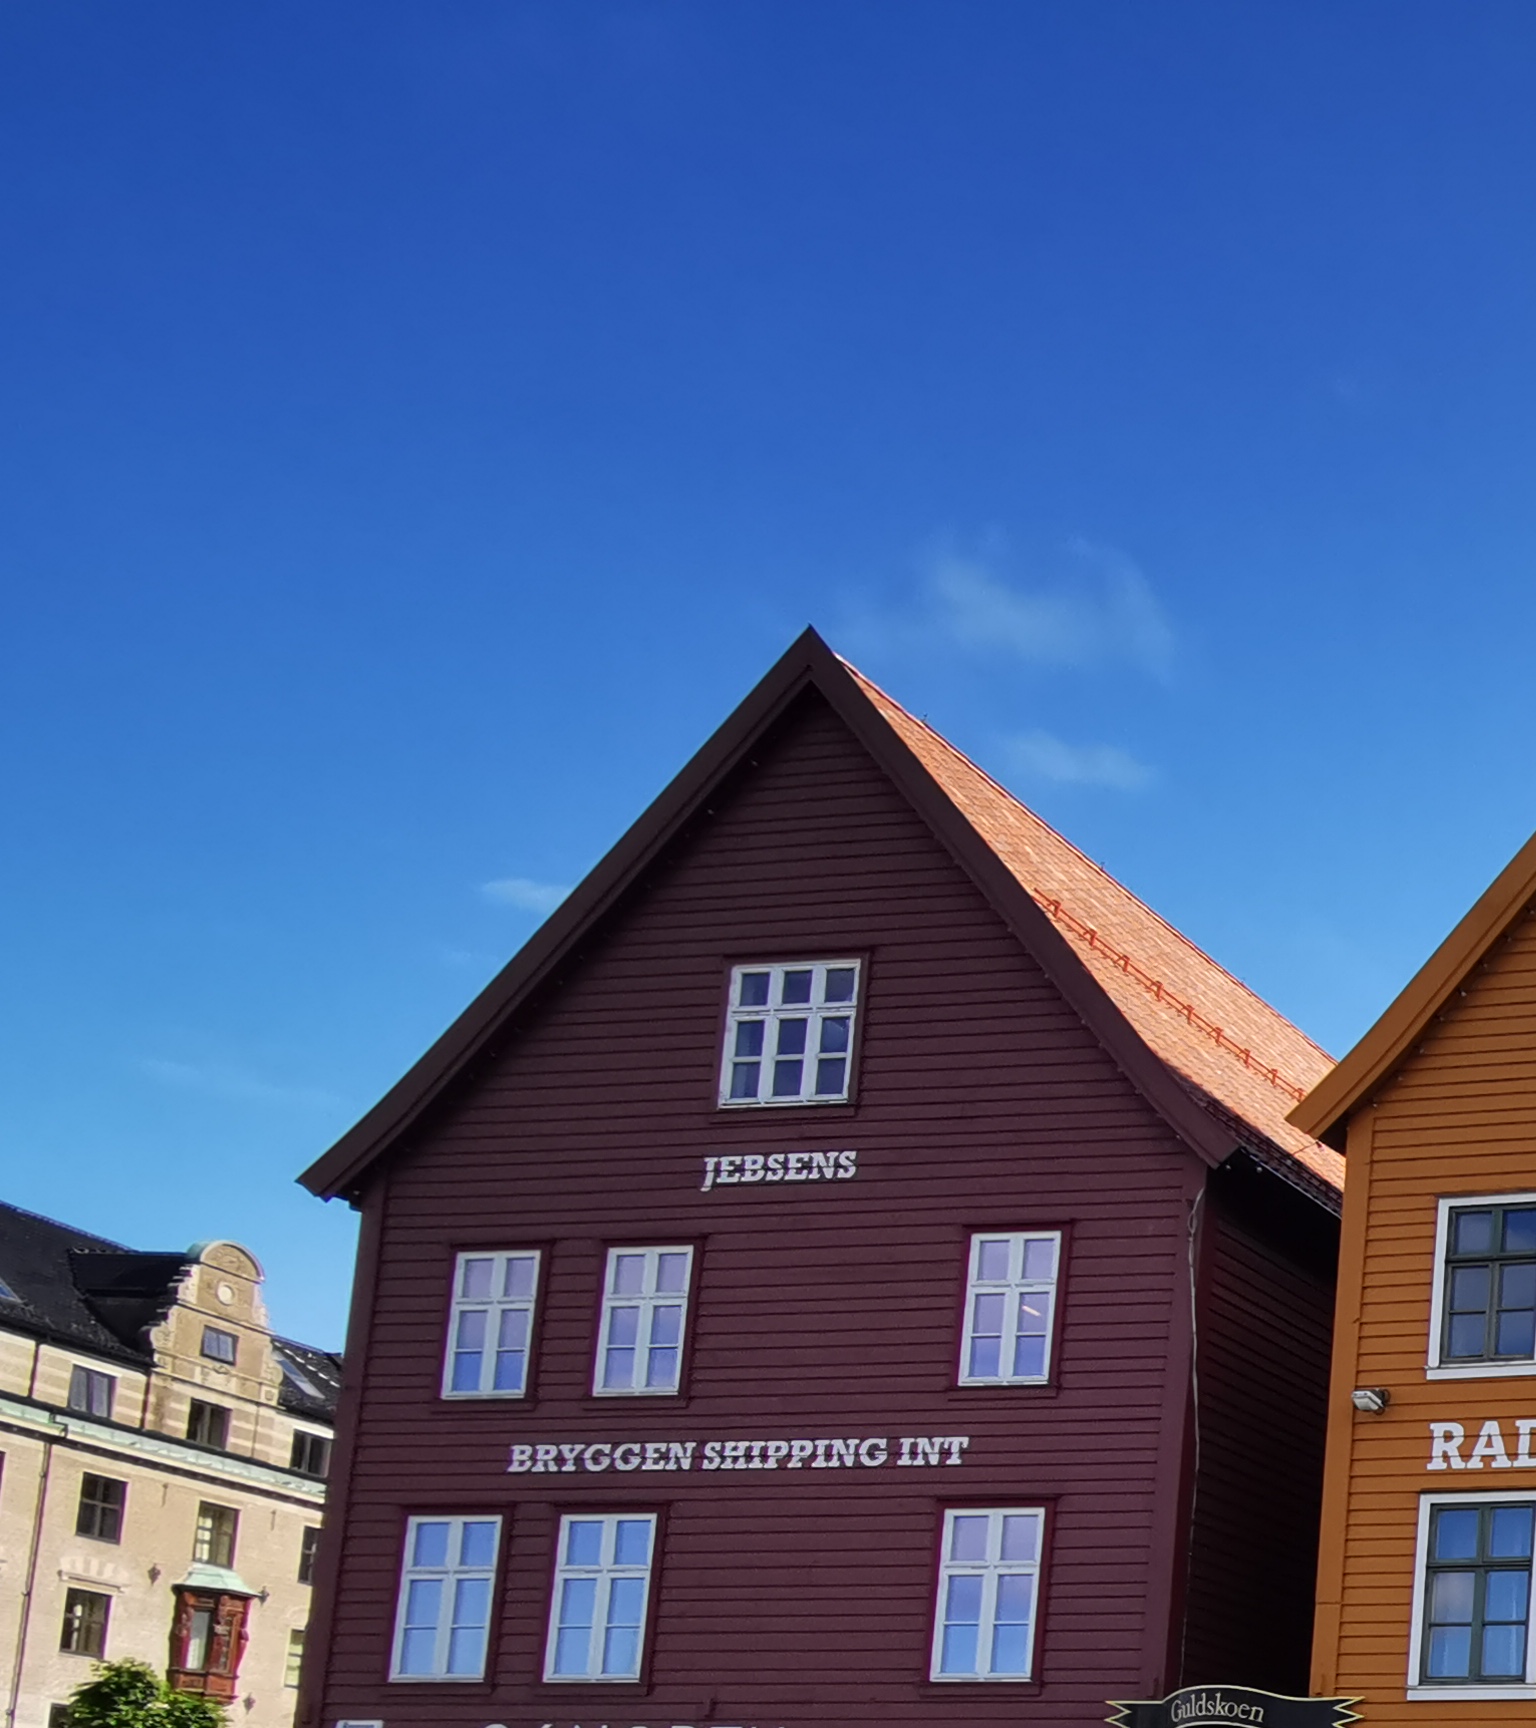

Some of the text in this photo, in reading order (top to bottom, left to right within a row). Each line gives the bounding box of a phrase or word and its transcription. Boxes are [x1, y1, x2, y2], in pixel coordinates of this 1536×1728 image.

[700, 1151, 857, 1192] JEBSENS
[506, 1437, 970, 1473] BRYGGEN SHIPPING INT
[1171, 1692, 1264, 1722] Guldskoen
